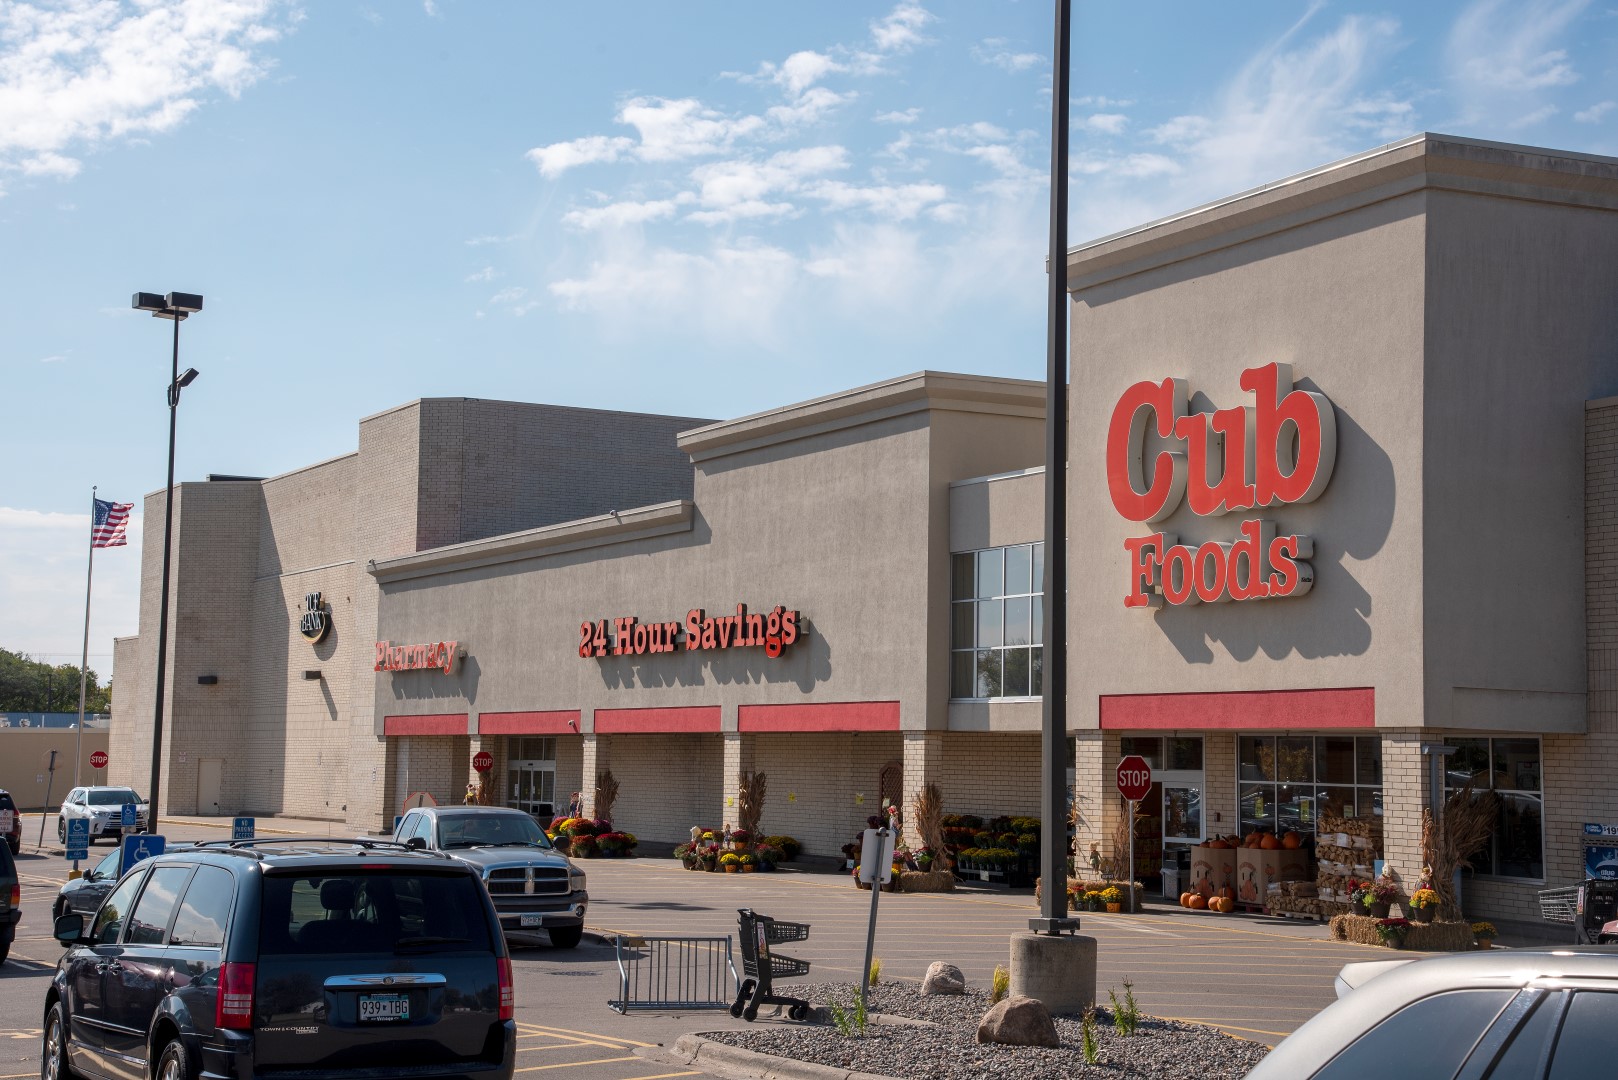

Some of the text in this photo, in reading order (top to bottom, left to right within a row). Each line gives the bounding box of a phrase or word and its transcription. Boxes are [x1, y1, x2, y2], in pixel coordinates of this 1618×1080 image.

[1106, 361, 1323, 522] Cub
[1123, 518, 1301, 608] Foods
[301, 610, 322, 631] BANK
[579, 602, 797, 659] 24 Hour Savings
[374, 640, 458, 676] Pharmacy
[90, 755, 108, 764] STOP
[474, 757, 493, 767] STOP
[1118, 769, 1149, 787] STOP
[361, 1000, 408, 1015] 939 TBG
